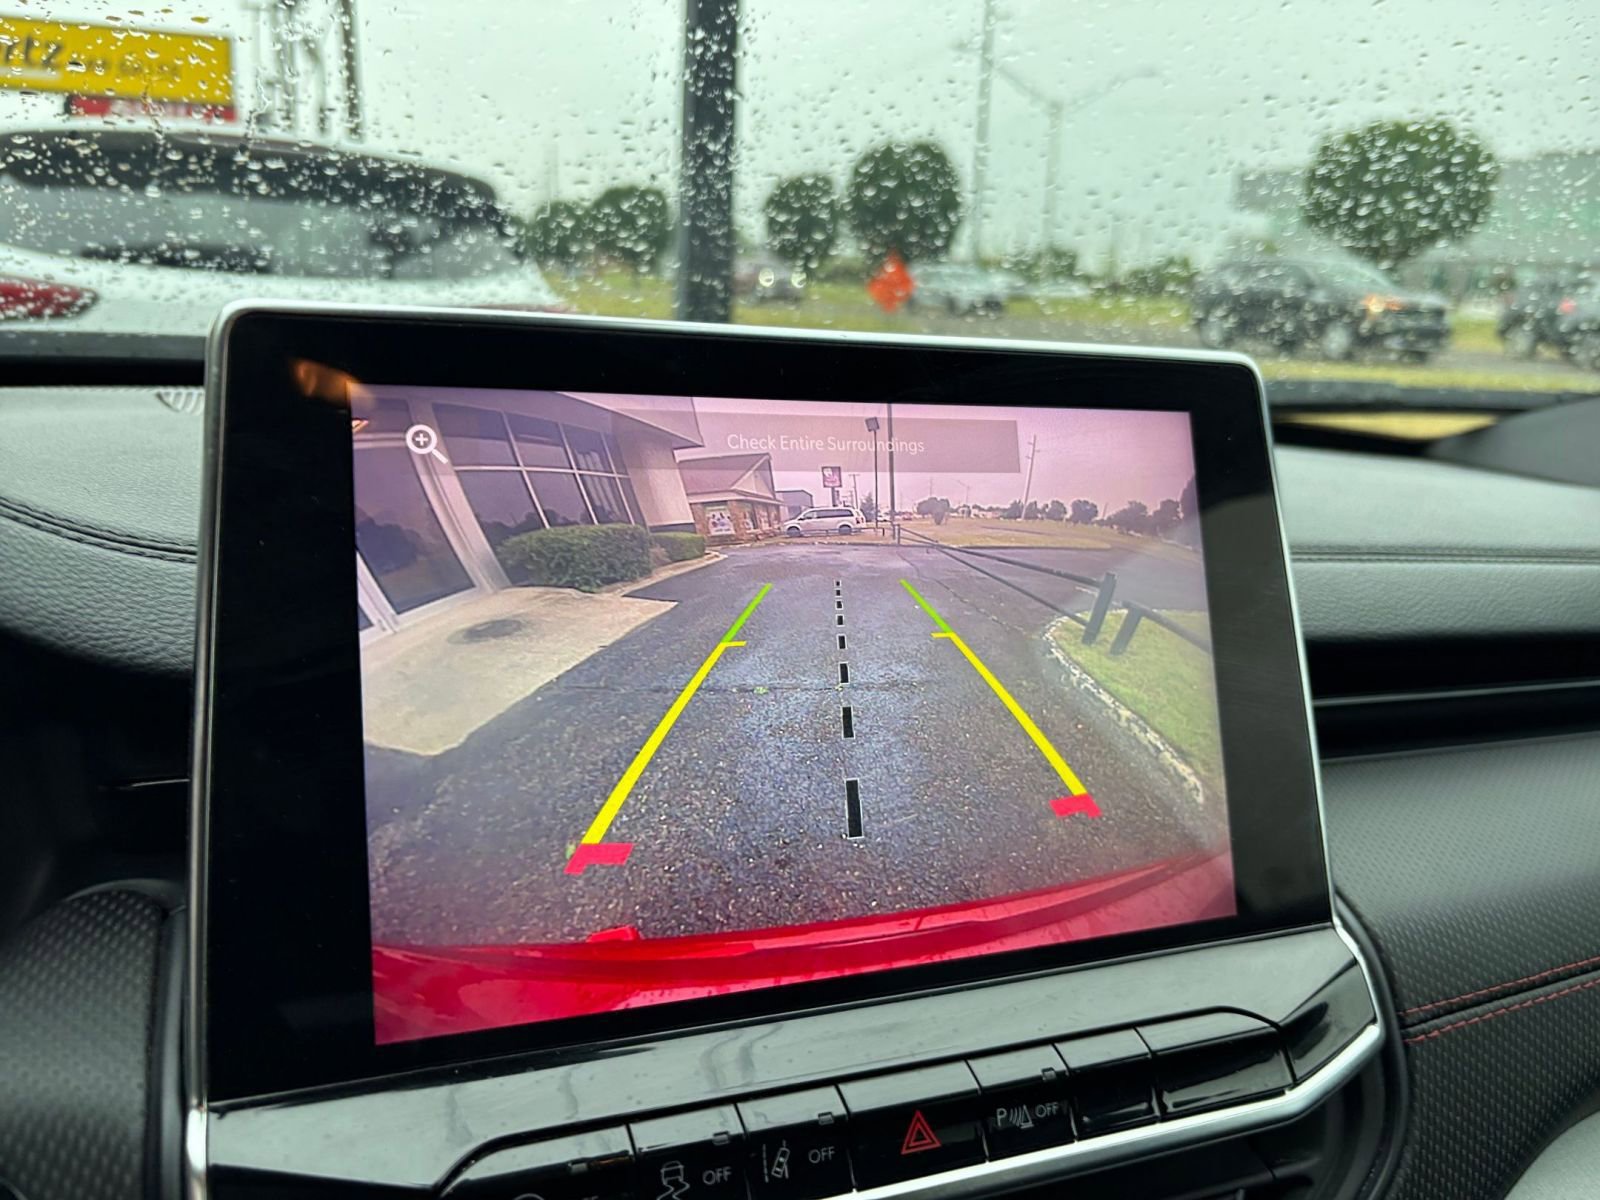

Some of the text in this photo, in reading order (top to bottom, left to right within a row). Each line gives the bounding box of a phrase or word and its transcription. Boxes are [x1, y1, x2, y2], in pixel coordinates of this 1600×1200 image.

[727, 434, 925, 455] Check Entire Surroundings
[1035, 1101, 1059, 1118] OFF
[808, 1146, 836, 1164] OFF
[702, 1166, 733, 1186] OFF
